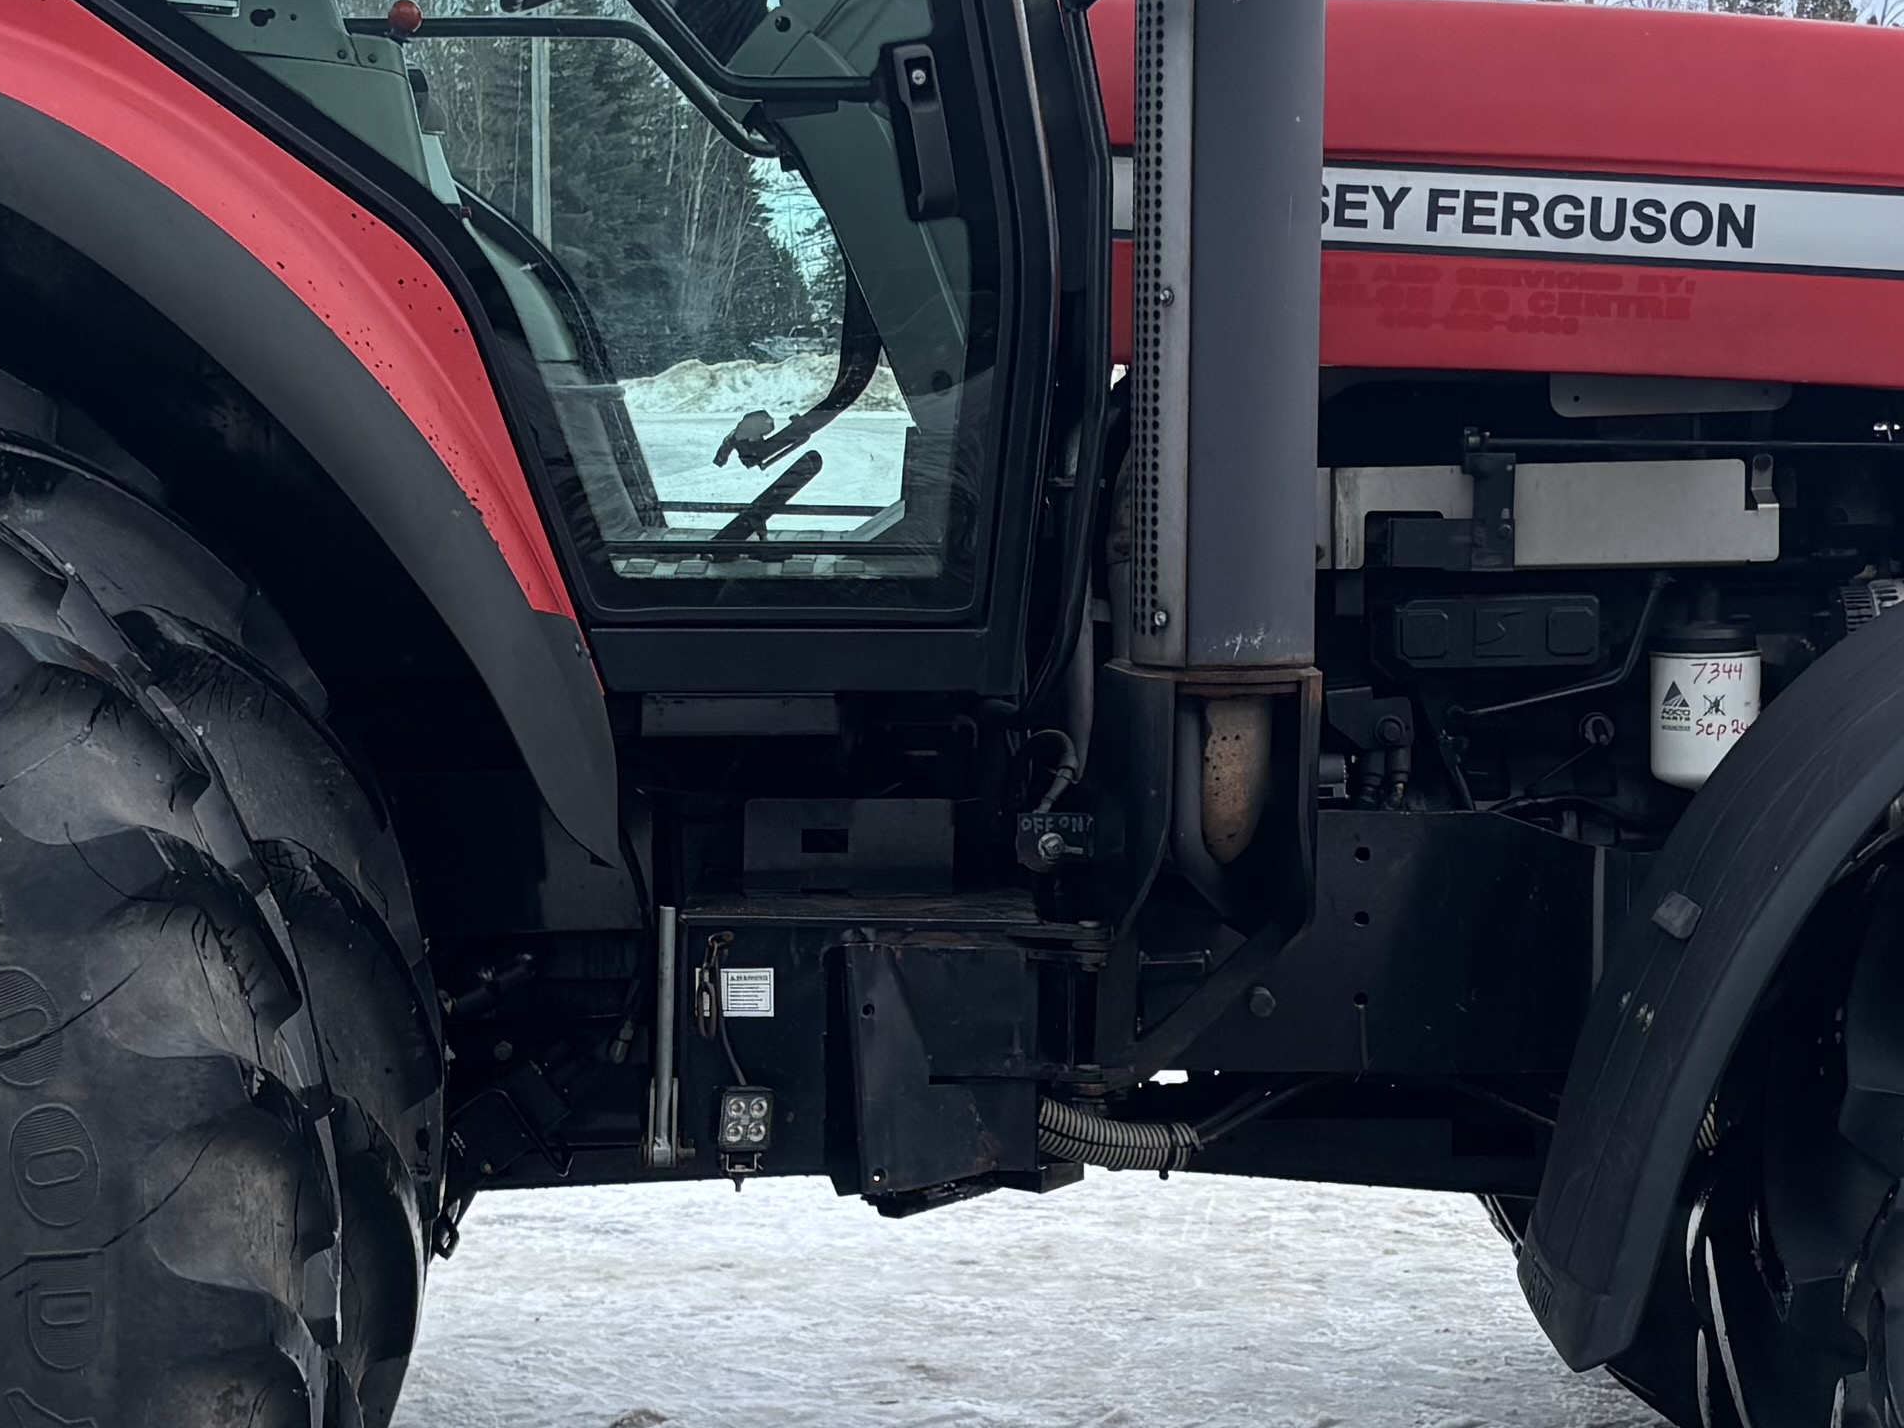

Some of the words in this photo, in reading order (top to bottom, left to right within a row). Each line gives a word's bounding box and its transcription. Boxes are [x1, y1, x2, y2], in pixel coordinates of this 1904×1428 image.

[1321, 183, 1412, 230] EY
[1426, 188, 1756, 249] FERGUSON
[1691, 662, 1743, 684] 7344
[1662, 708, 1690, 716] AGCO
[1695, 718, 1727, 742] Sep
[1021, 816, 1054, 834] OFF
